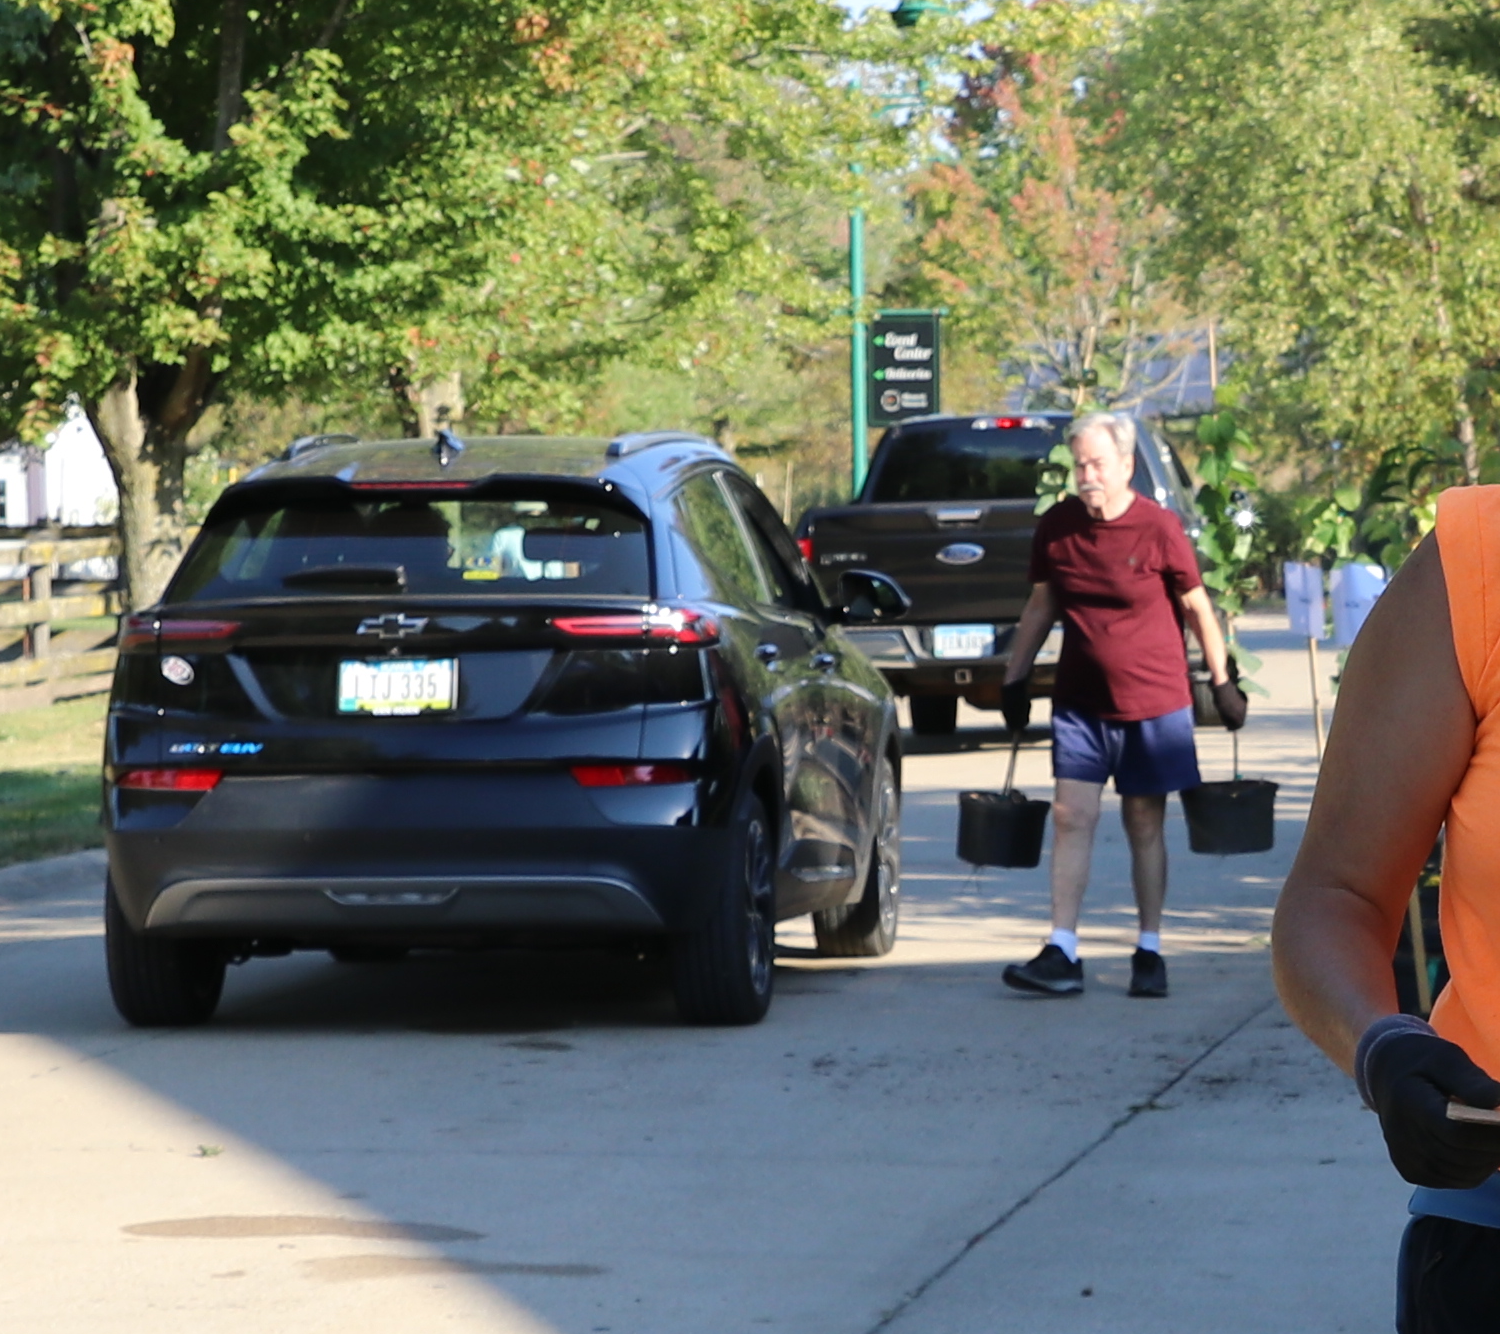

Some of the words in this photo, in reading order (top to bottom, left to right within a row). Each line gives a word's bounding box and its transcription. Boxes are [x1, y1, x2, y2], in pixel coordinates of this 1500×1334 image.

[884, 331, 918, 348] Event
[893, 347, 933, 362] Center
[355, 673, 392, 700] LIJ
[400, 673, 438, 700] 335
